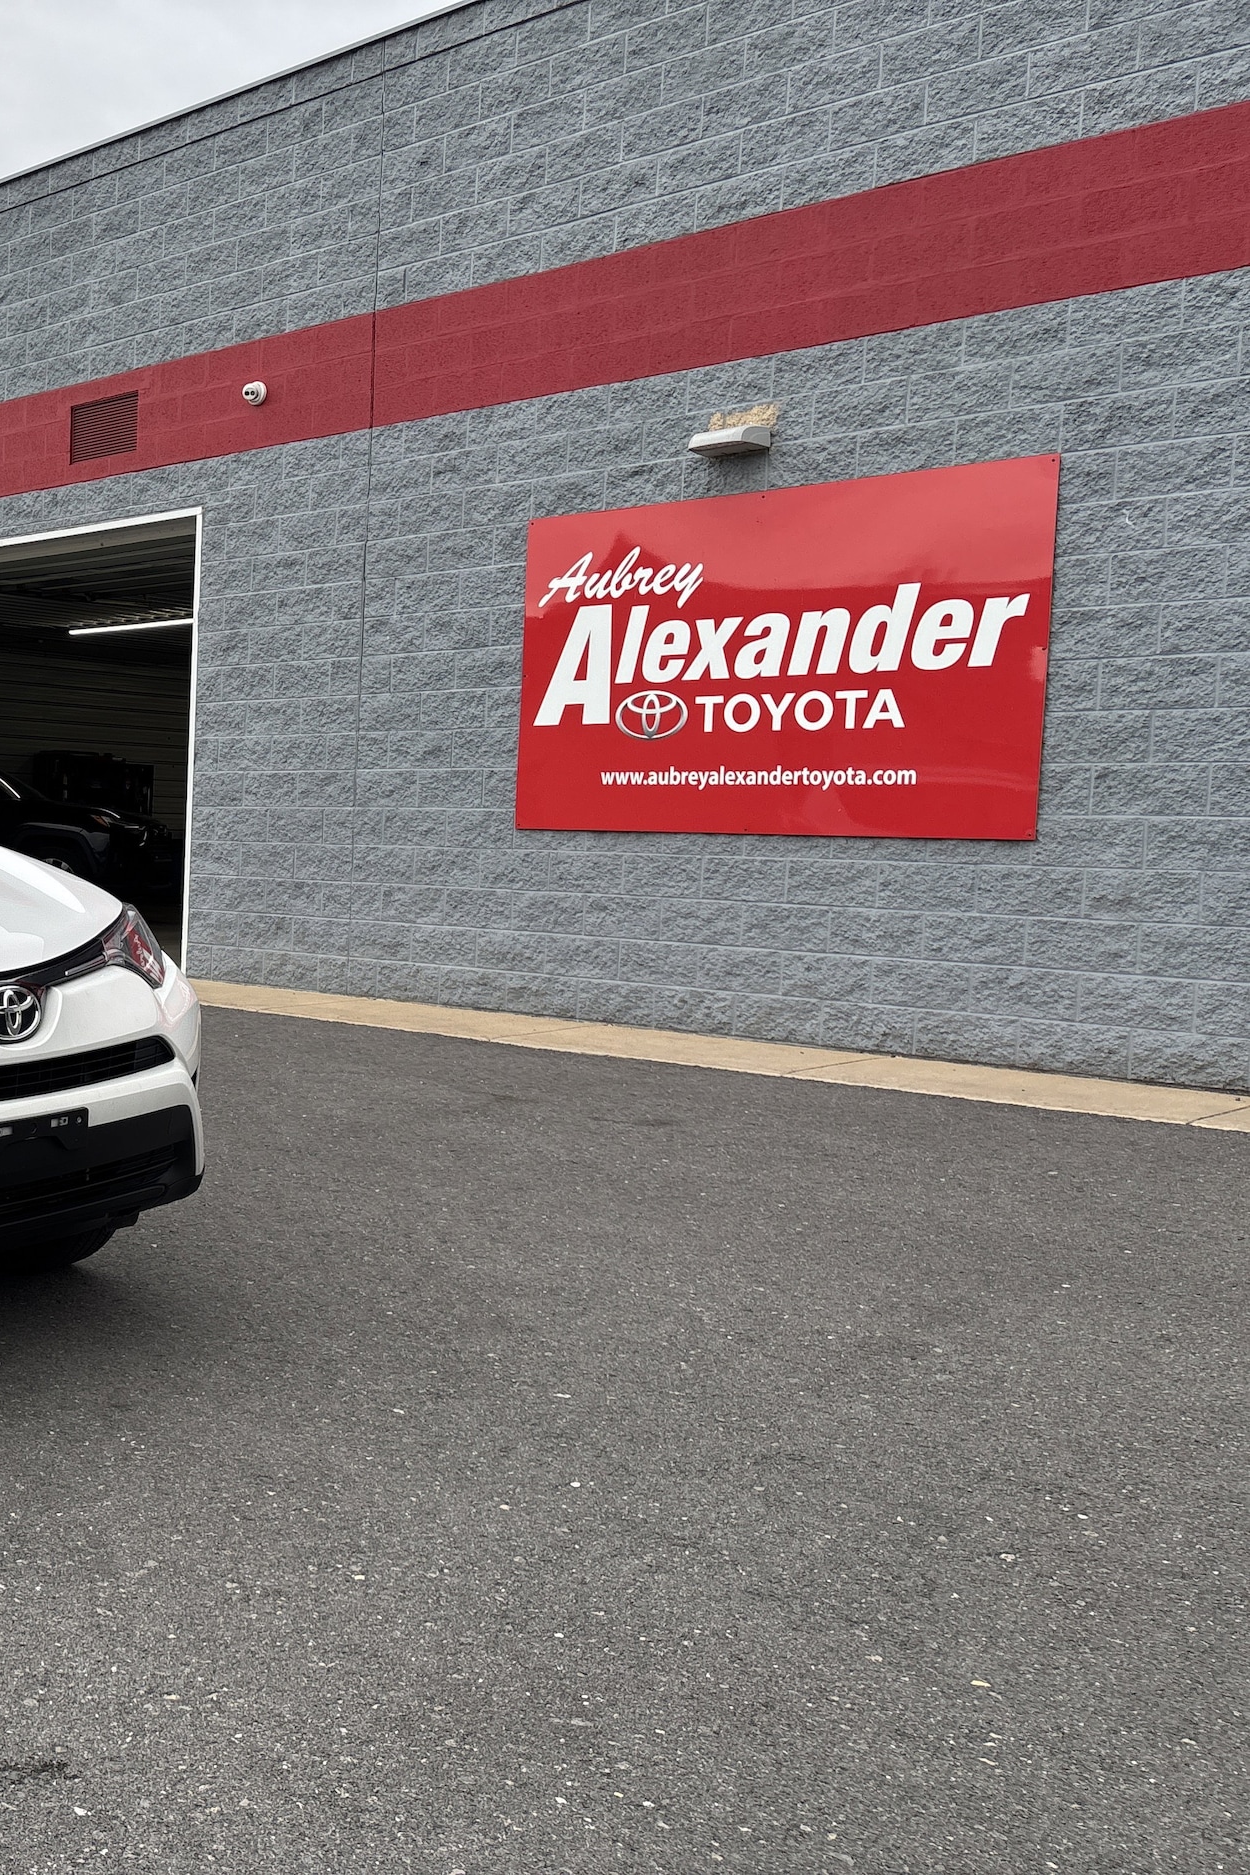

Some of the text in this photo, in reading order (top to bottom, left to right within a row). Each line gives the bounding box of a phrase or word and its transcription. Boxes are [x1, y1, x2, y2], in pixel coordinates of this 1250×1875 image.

[538, 546, 704, 608] Aubrey
[533, 582, 1031, 726] Alexander
[695, 688, 905, 733] TOYOTA
[600, 765, 917, 790] www.aubreyalexandertoyota.com
